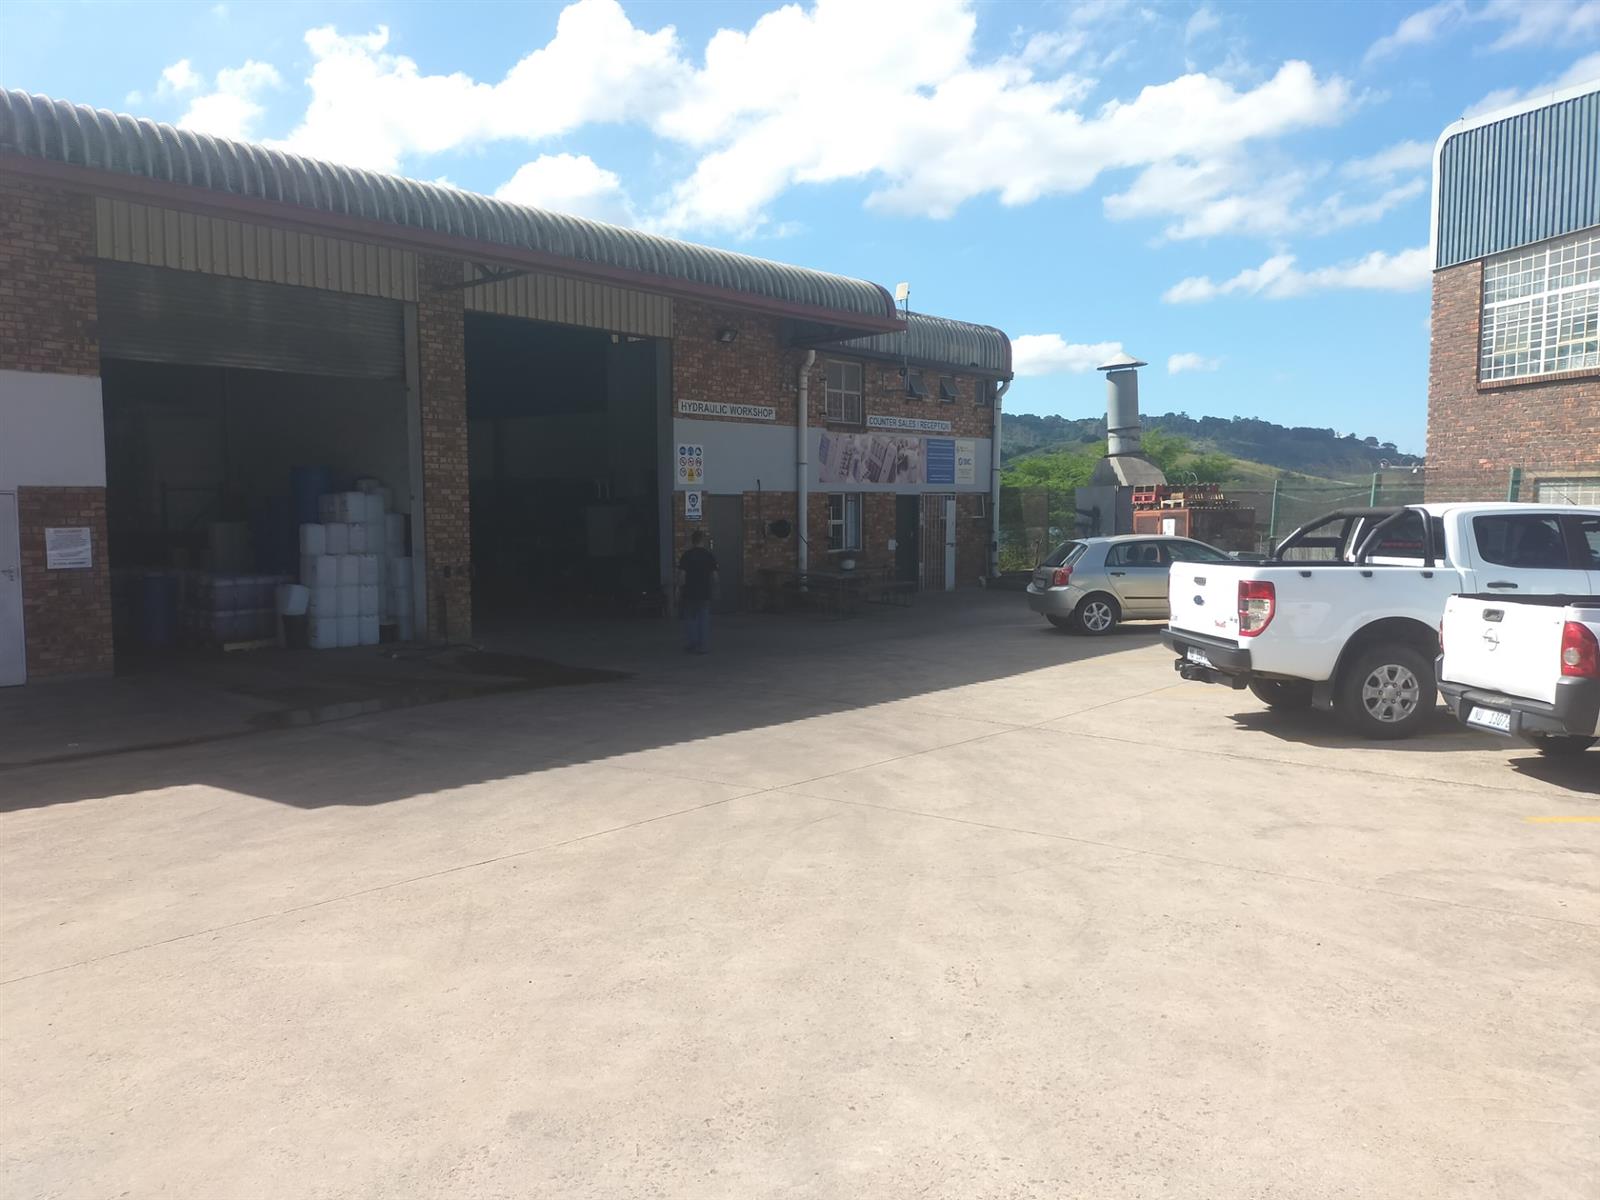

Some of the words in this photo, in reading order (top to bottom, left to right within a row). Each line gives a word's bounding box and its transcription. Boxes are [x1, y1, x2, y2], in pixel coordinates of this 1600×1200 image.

[681, 402, 727, 414] HYDRAULIC
[730, 405, 773, 418] WORKSHOP
[869, 416, 897, 426] COUNTER
[898, 418, 916, 428] SALES
[920, 420, 950, 431] RECEPTION
